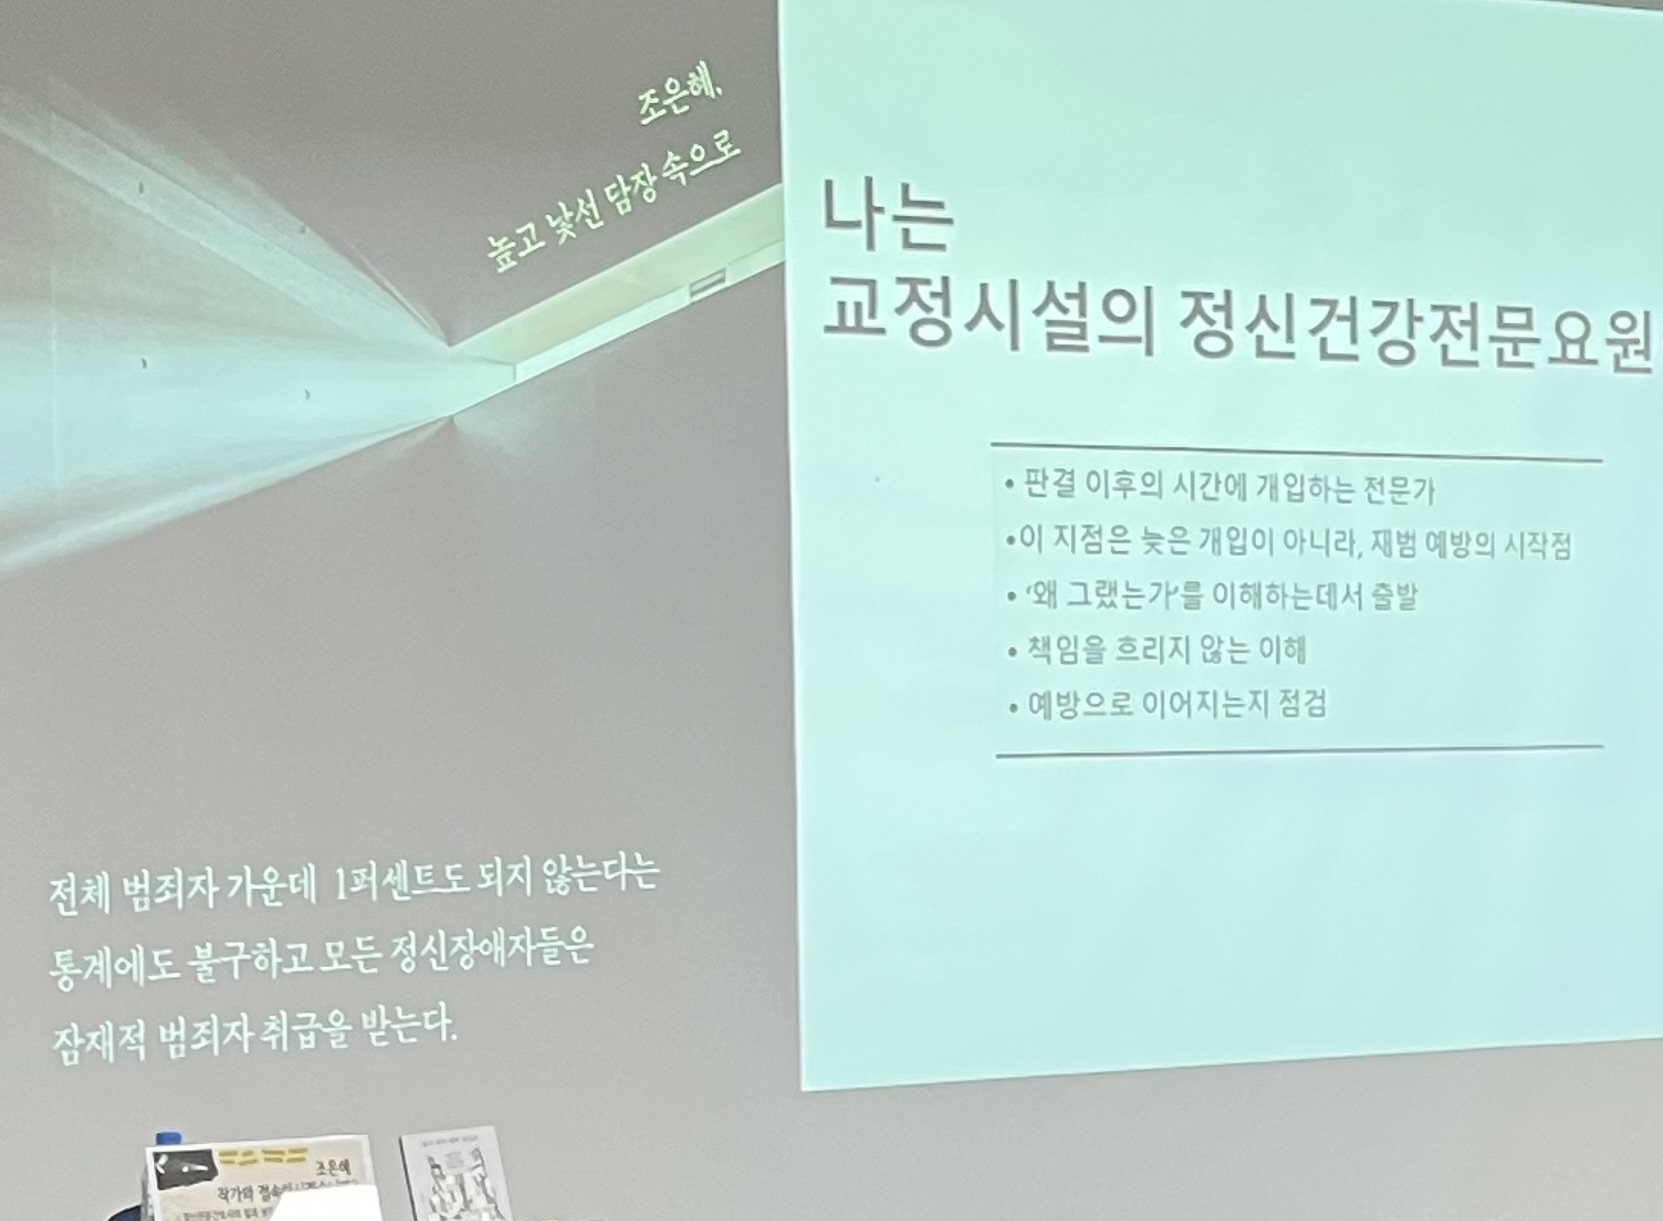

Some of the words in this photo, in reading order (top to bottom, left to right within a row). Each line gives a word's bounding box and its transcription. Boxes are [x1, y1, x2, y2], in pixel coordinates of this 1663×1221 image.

[486, 223, 546, 273] 높고
[545, 188, 604, 245] 낯선
[604, 163, 657, 215] 담장
[662, 130, 741, 185] 속으로
[825, 176, 954, 251] 나는
[824, 276, 1153, 357] 교정시설의
[1025, 468, 1074, 498] 판결
[1086, 469, 1162, 499] 이후의
[1173, 470, 1247, 502] 시간에
[1257, 473, 1355, 504] 개입하는
[1365, 476, 1435, 506] 전문가
[1020, 524, 1042, 554] 이
[1054, 524, 1131, 554] 지점은
[1141, 526, 1191, 555] 늦은
[1200, 526, 1273, 556] 개입이
[1284, 528, 1362, 559] 아니라,
[1371, 530, 1416, 558] 재범
[1426, 531, 1494, 559] 예방의
[1505, 531, 1570, 560] 시작점
[1213, 582, 1362, 611] 이해하는데서
[1372, 583, 1418, 611] 출발
[1029, 635, 1106, 665] 책임을
[1116, 635, 1189, 665] 흐리지
[1201, 635, 1250, 664] 않는
[1260, 635, 1305, 665] 이해
[1029, 691, 1133, 720] 예방으로
[1143, 689, 1268, 720] 이어지는지
[1280, 689, 1325, 718] 점검
[50, 871, 109, 916] 전체
[123, 866, 220, 912] 범죄자
[228, 863, 315, 907] 가운데
[336, 860, 470, 901] 1퍼센트도
[477, 855, 531, 897] 되지
[543, 851, 660, 895] 않는다는
[49, 944, 180, 992] 통계에도
[188, 937, 314, 983] 불구하고
[320, 936, 383, 973] 모든
[391, 925, 594, 973] 정신장애자들은
[53, 1019, 145, 1066] 잠재적
[159, 1013, 255, 1059] 범죄자
[261, 1009, 352, 1052] 취급을
[362, 1001, 457, 1046] 받는다.
